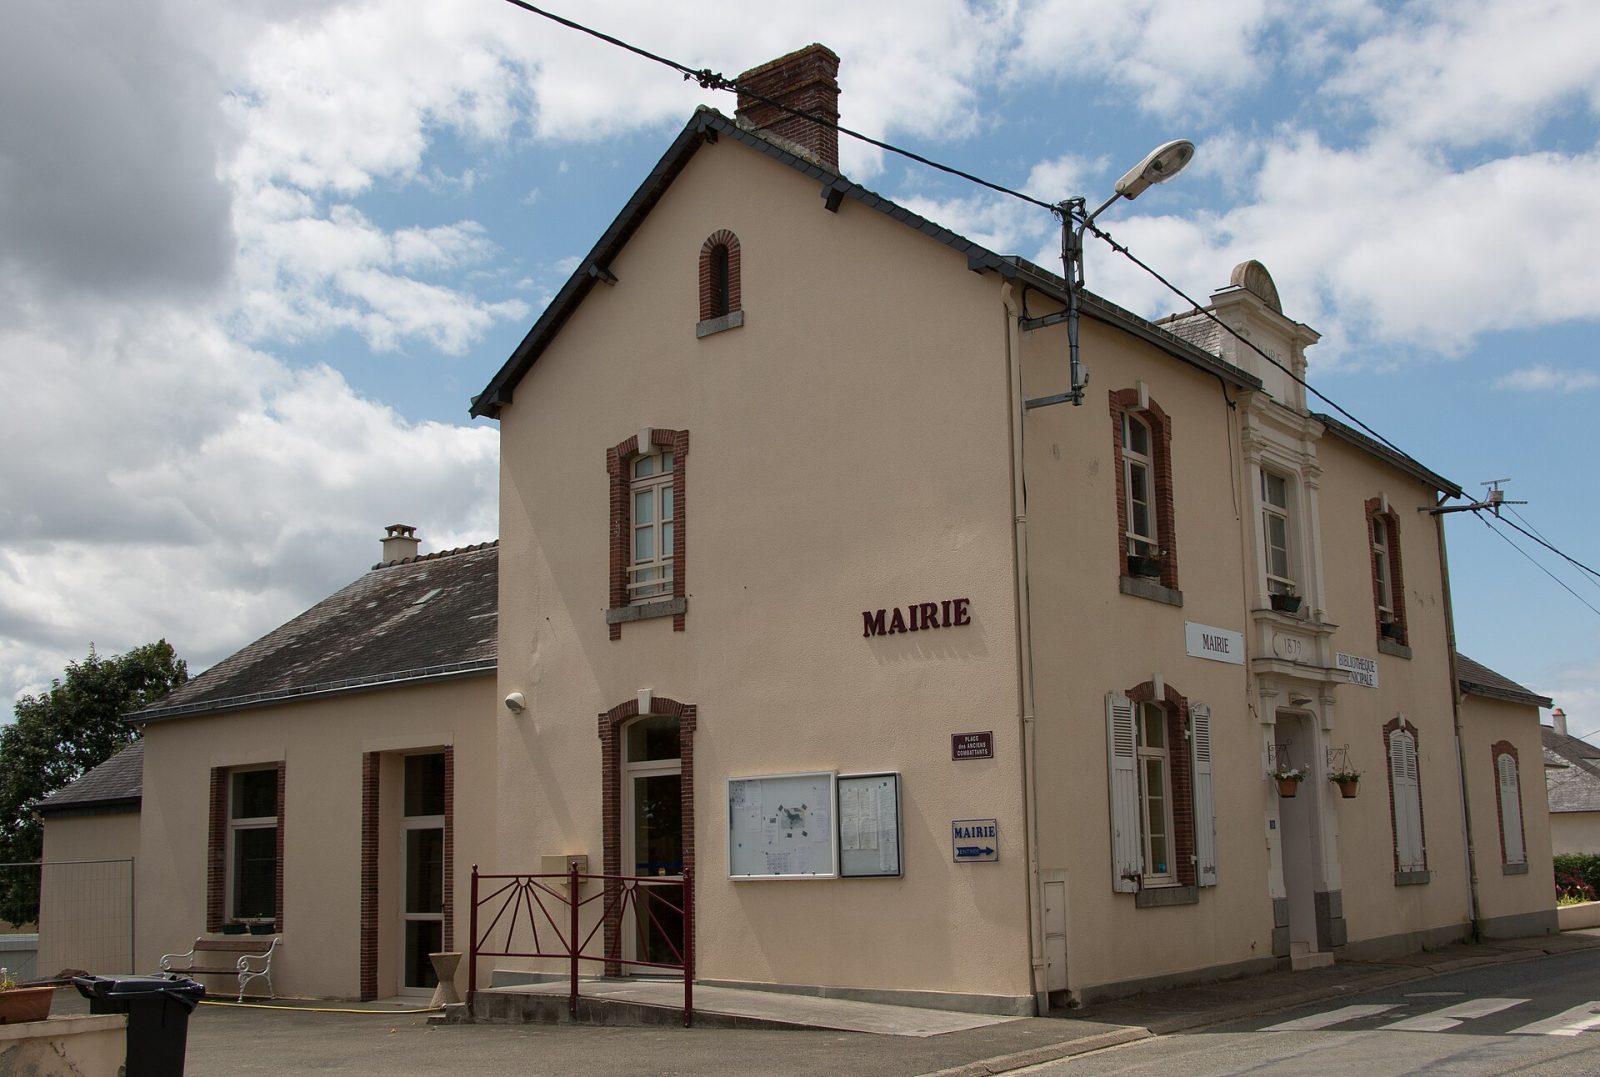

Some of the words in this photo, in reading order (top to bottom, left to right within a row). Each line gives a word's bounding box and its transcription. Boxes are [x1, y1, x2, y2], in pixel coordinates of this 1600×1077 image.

[862, 598, 971, 637] MAIRIE
[1202, 633, 1229, 653] MAIRIE
[954, 826, 995, 838] MAIRIE
